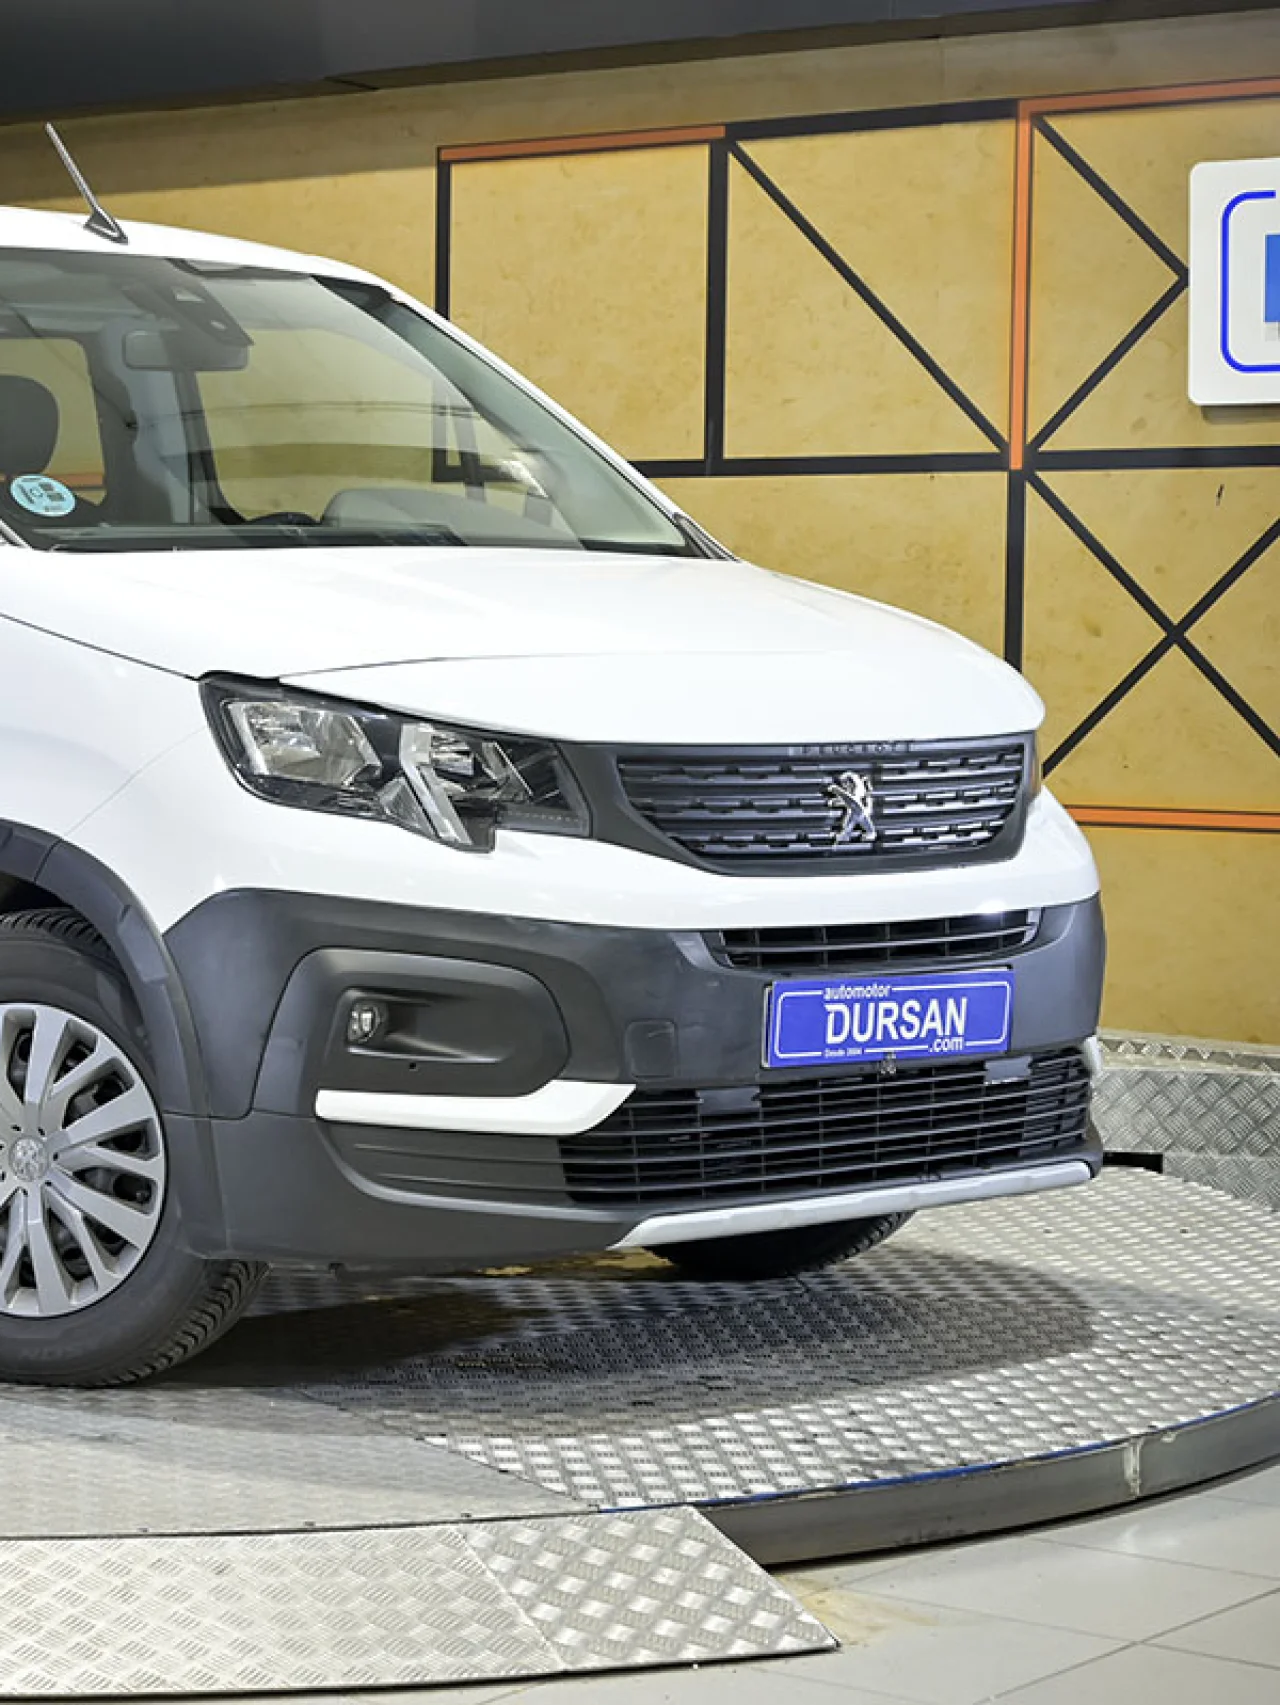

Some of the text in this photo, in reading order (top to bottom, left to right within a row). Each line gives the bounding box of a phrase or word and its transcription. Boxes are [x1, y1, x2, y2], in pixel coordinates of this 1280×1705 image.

[823, 982, 891, 1000] automotor
[823, 997, 968, 1045] DURSAN
[929, 1036, 964, 1053] .com
